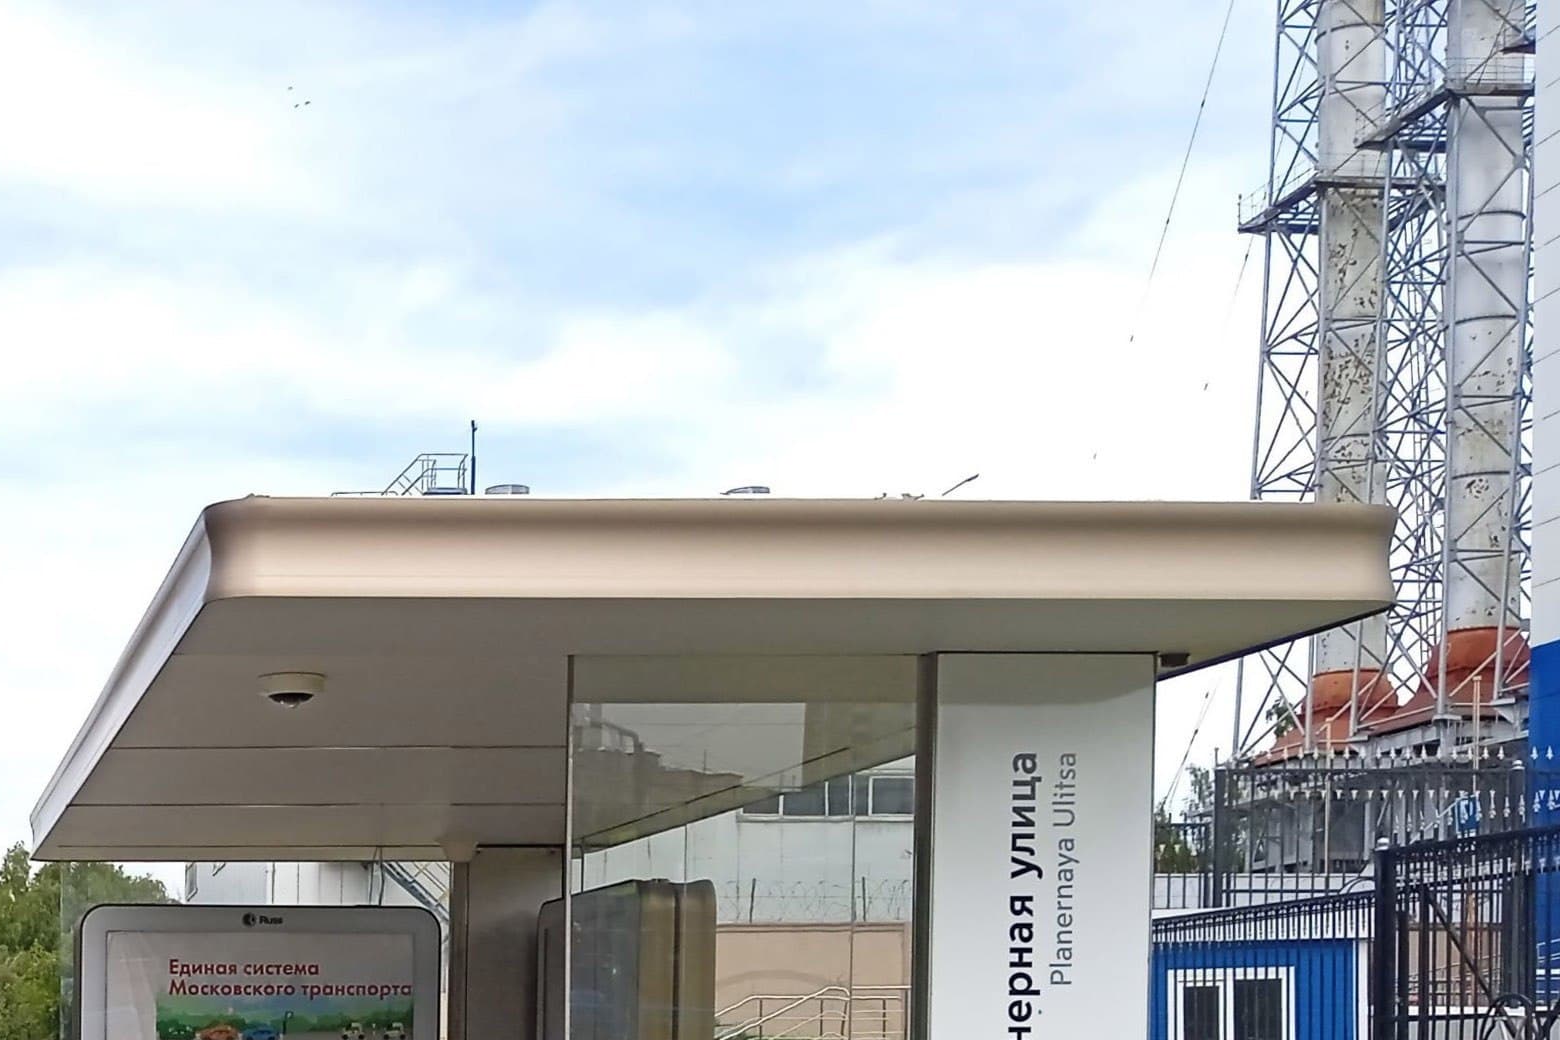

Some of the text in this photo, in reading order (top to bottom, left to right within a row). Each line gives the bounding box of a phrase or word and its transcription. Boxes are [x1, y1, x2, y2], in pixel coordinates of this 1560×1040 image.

[1010, 752, 1043, 879] улица
[1049, 752, 1080, 985] Planernaya Ulitsa
[168, 979, 412, 1000] Московского транспорта
[169, 959, 320, 977] Единая система
